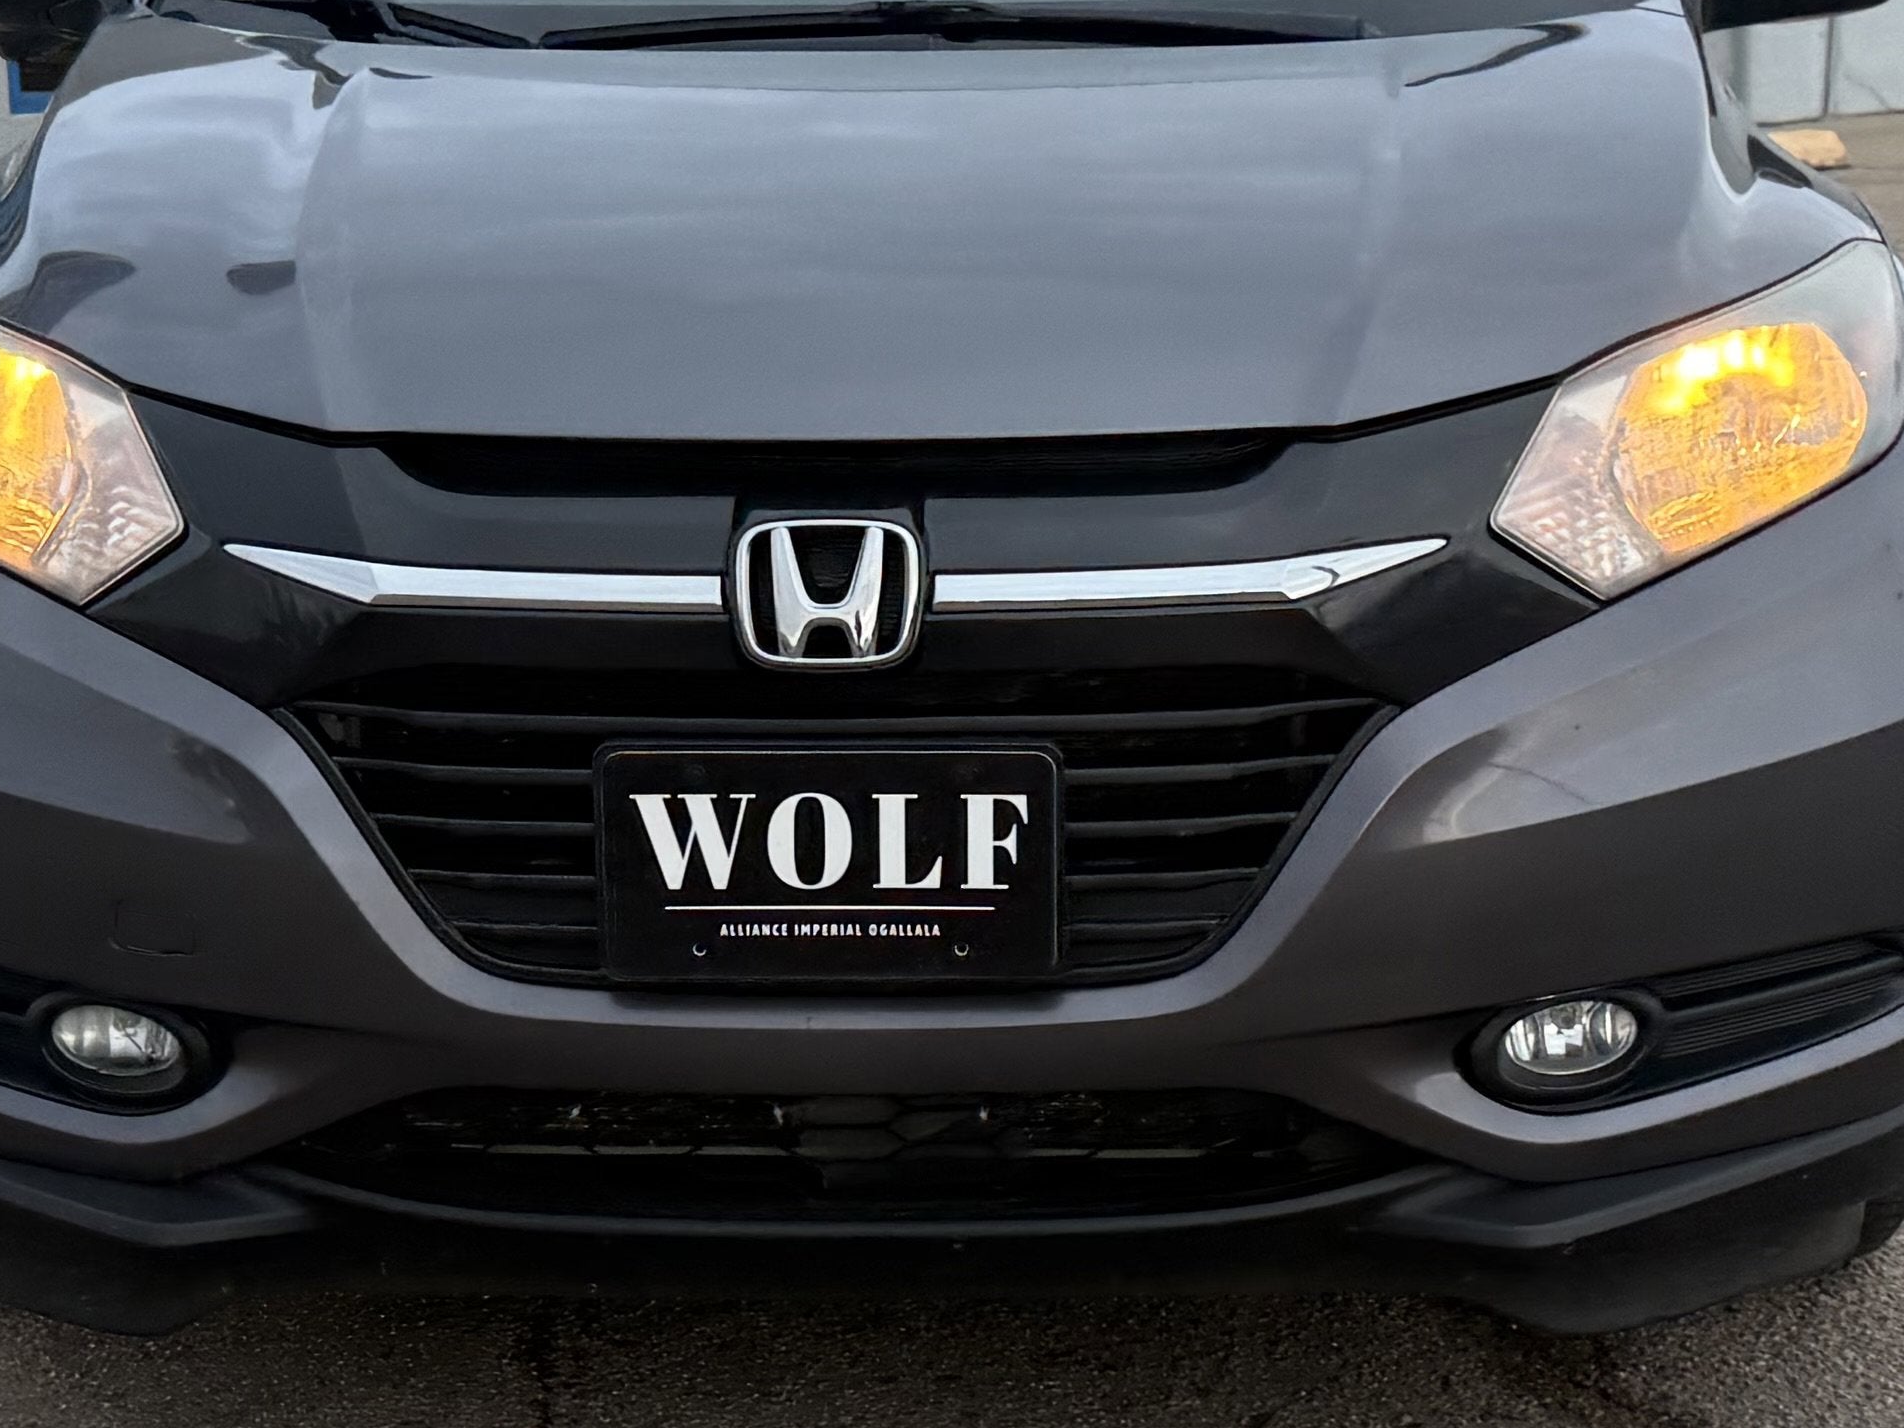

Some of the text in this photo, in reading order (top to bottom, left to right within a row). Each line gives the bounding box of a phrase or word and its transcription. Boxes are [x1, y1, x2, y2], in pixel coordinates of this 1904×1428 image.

[628, 791, 1029, 891] WOLF
[720, 923, 941, 937] ALLIANCE IMPERIAL OGALLALA
